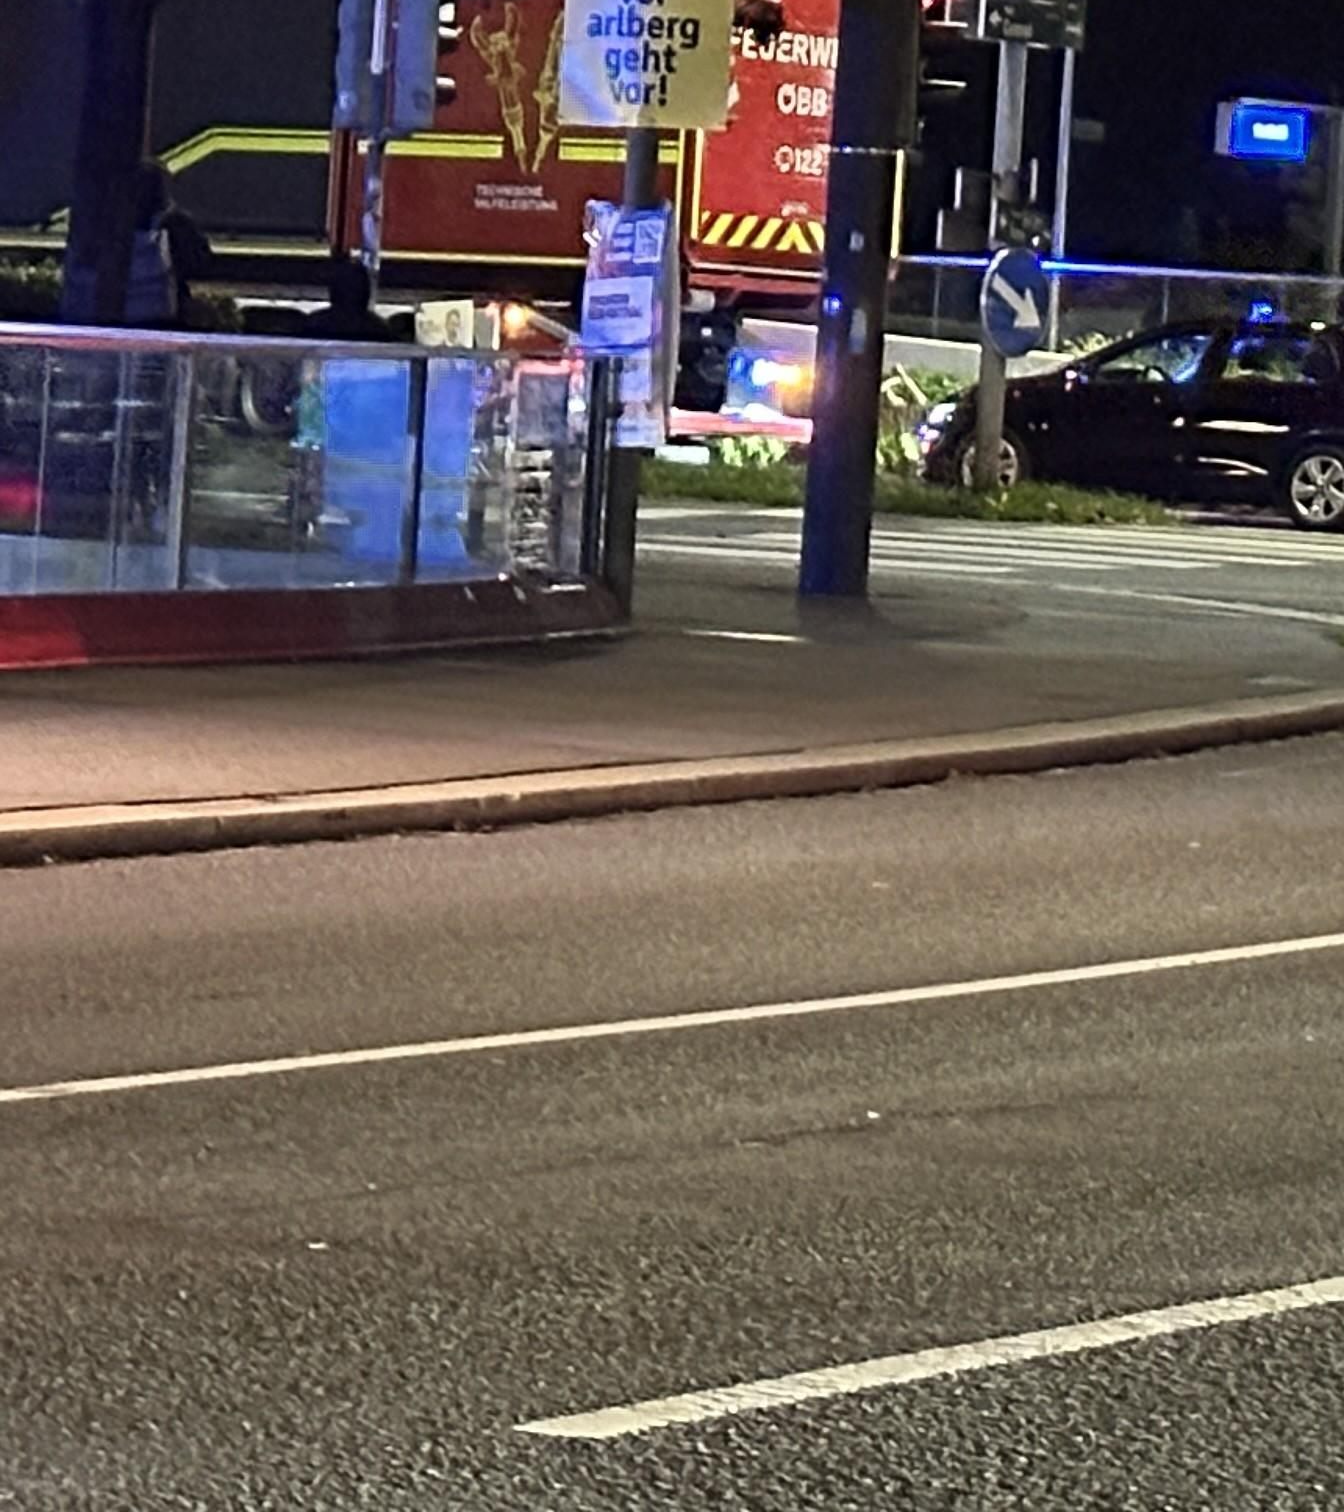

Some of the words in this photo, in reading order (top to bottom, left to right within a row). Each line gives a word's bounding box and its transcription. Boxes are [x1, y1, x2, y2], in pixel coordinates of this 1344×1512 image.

[587, 4, 700, 49] arlberg
[605, 40, 677, 80] geht
[609, 74, 667, 107] vor!
